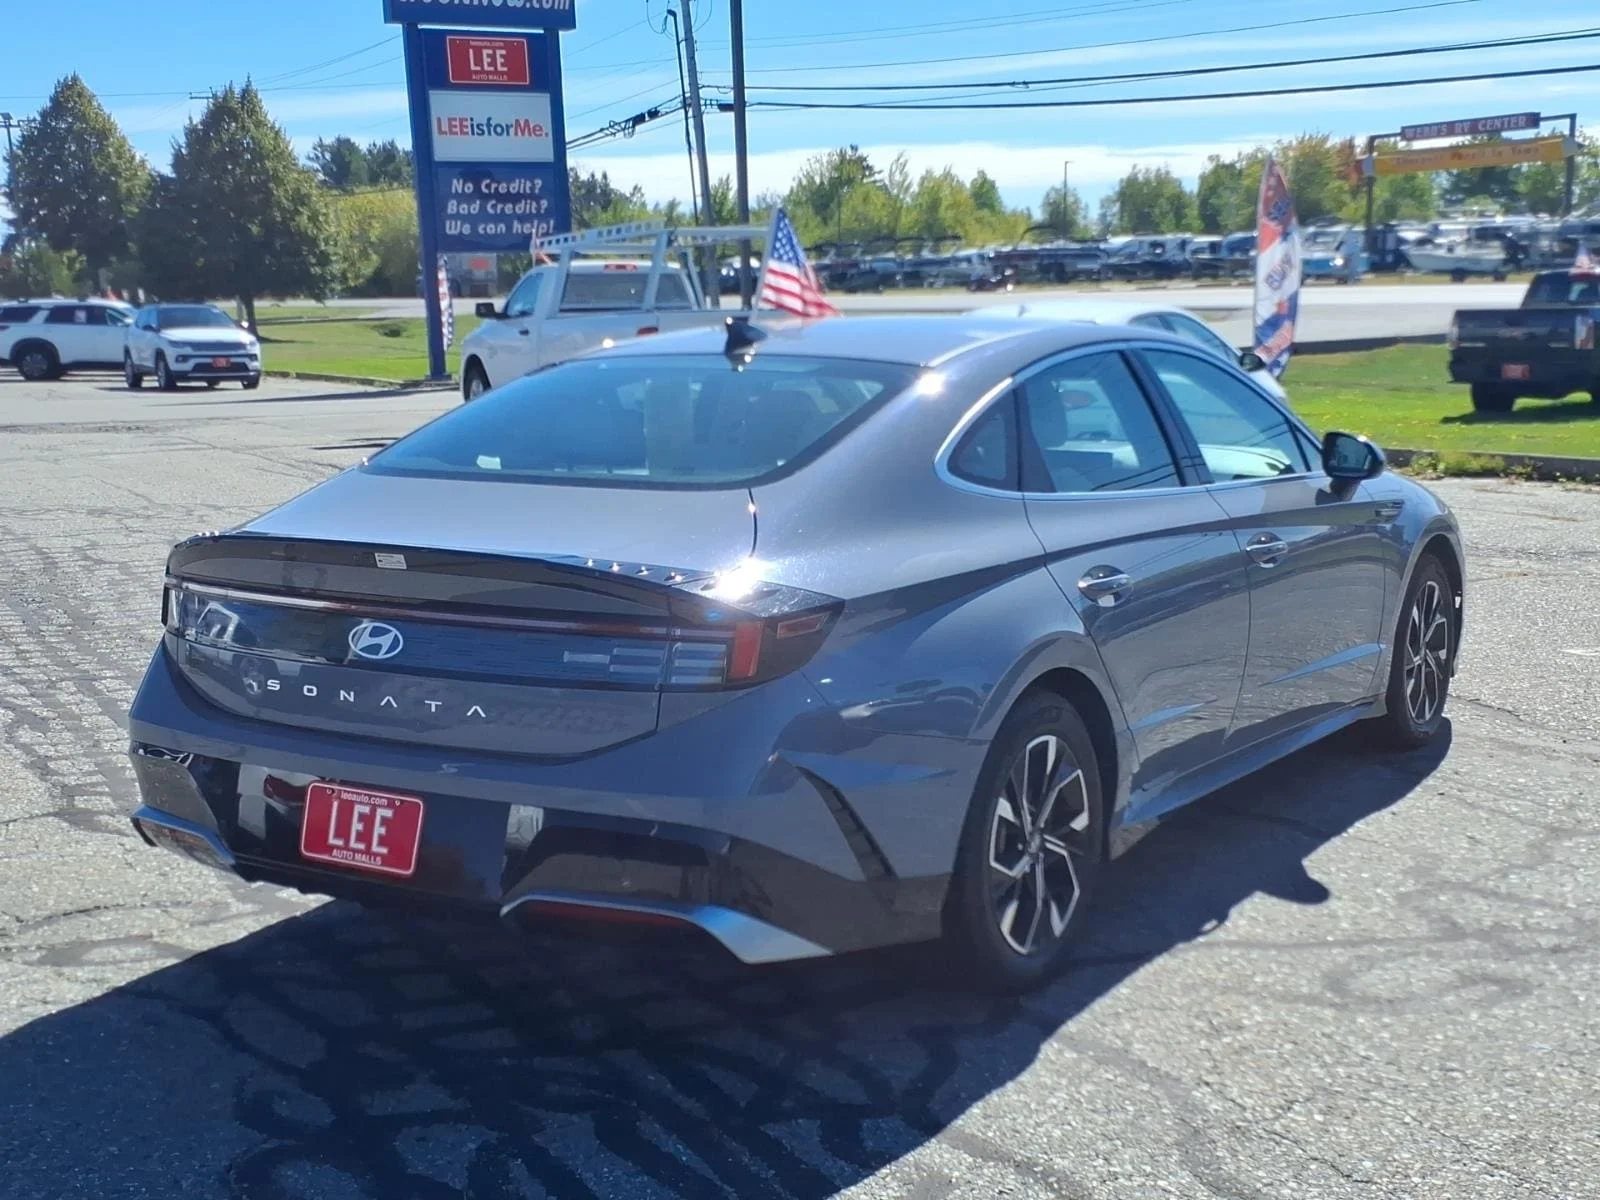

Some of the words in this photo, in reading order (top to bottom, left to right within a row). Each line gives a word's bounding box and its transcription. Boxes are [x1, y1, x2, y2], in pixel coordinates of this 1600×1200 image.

[469, 48, 508, 71] LEE
[436, 117, 550, 137] LEEisforMe.
[1478, 116, 1526, 131] CENTER
[451, 178, 474, 194] No
[480, 178, 543, 194] Credit?
[447, 200, 480, 215] Bad
[486, 200, 549, 215] Credit?
[445, 220, 471, 235] We
[478, 223, 506, 235] can
[513, 220, 555, 238] help!
[266, 679, 487, 718] SONATA
[340, 790, 388, 806] leeauto.com
[328, 799, 395, 855] LEE
[332, 848, 354, 860] AUTO
[354, 851, 382, 866] MALLS
